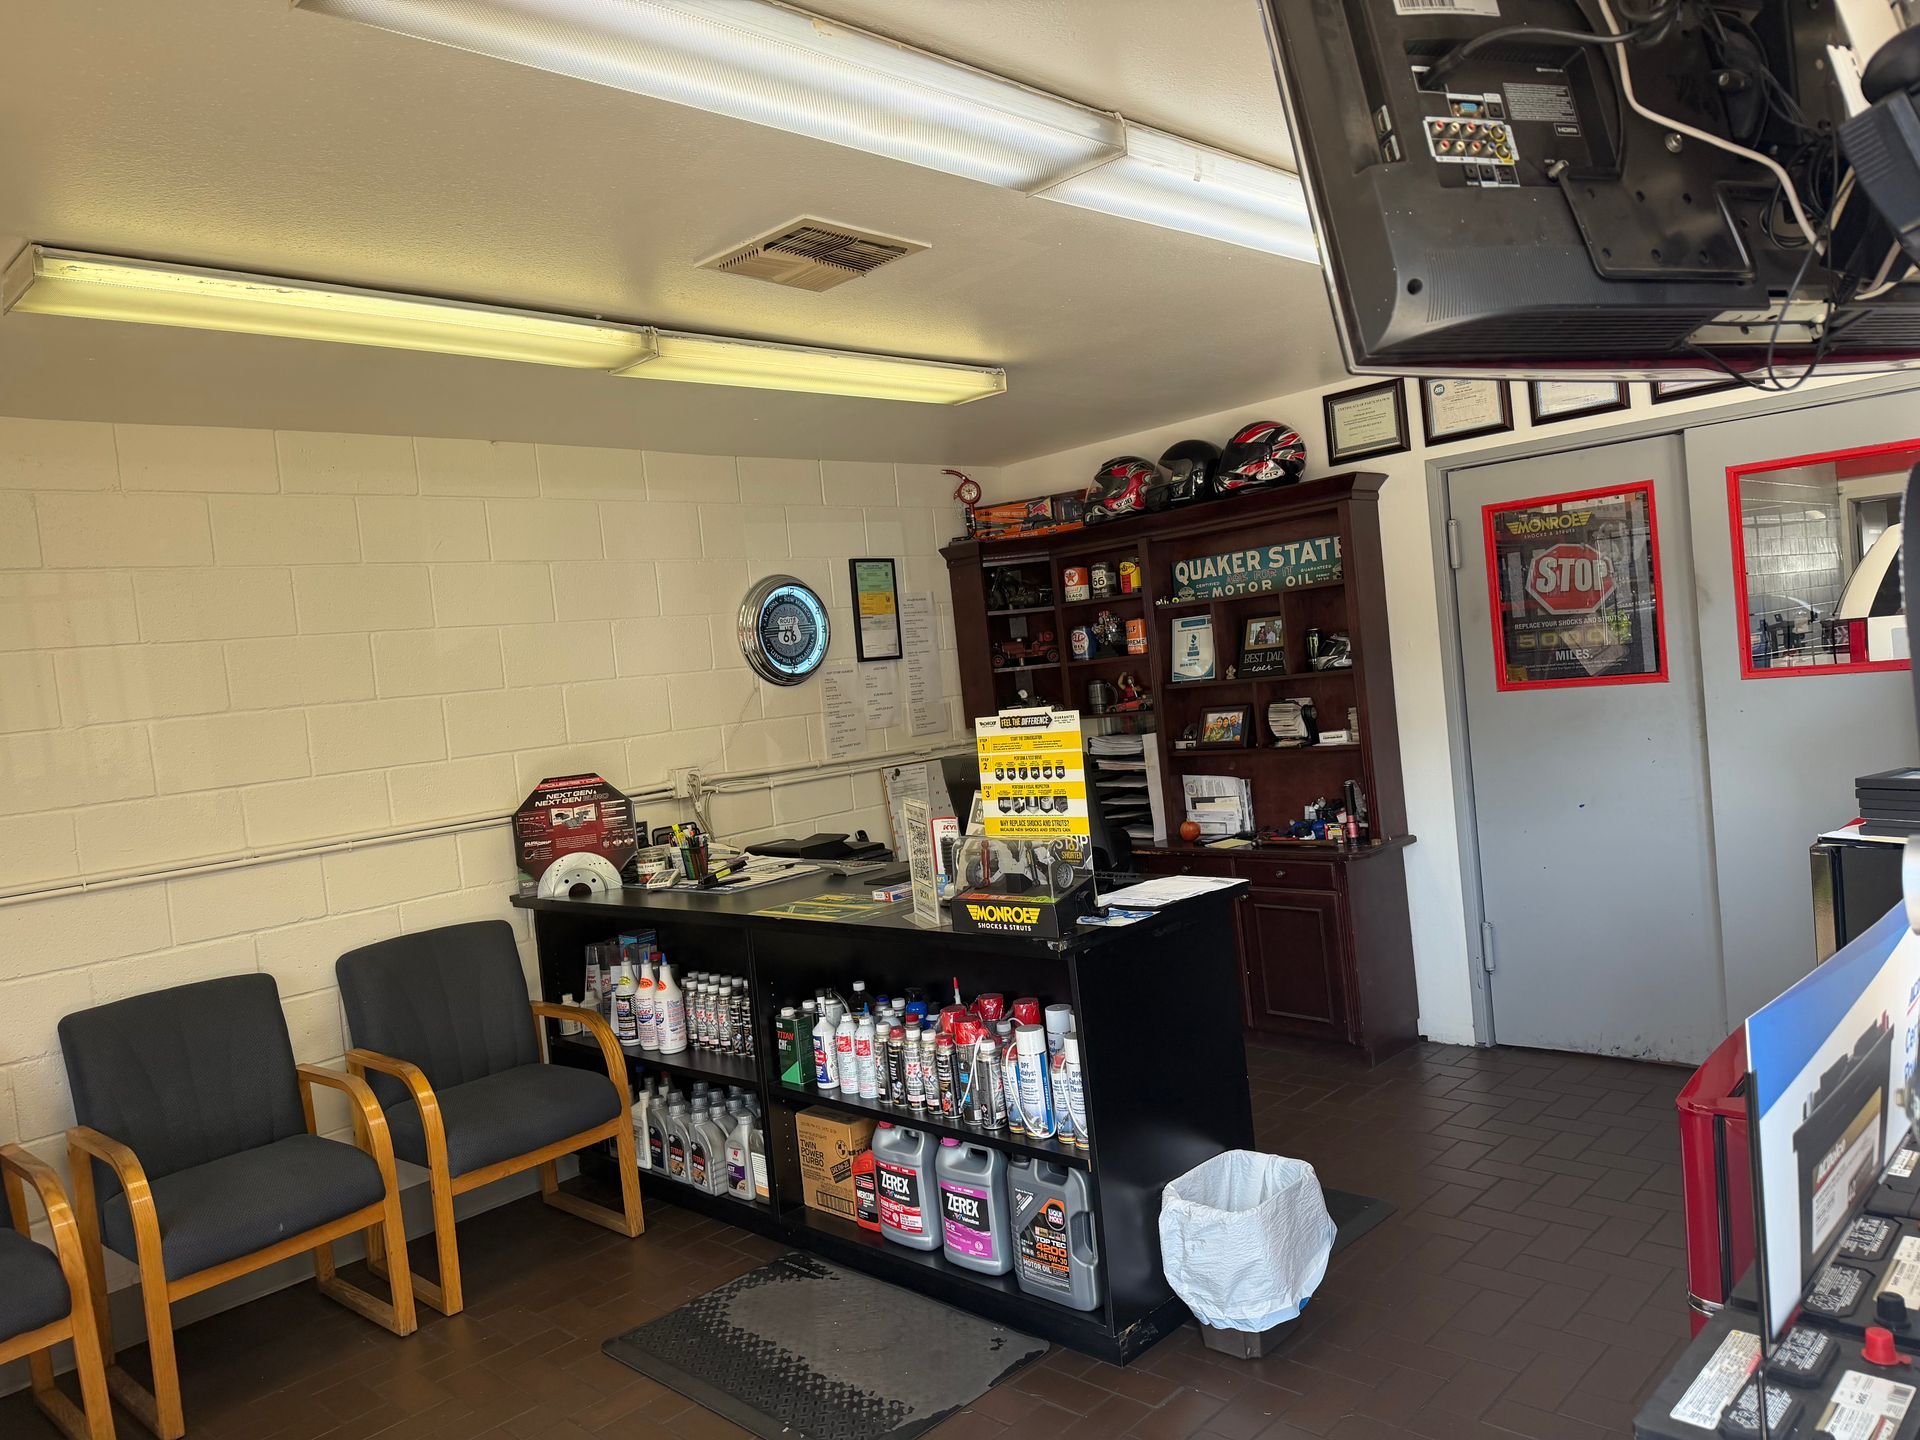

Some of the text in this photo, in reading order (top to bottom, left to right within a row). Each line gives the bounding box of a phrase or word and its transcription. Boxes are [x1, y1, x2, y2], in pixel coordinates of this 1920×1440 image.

[1518, 513, 1580, 534] MONROE
[1174, 550, 1262, 586] QUAKER
[1536, 556, 1609, 594] STOP
[1211, 573, 1314, 599] MOTOR OIL
[1514, 622, 1541, 630] REPLACE
[1558, 619, 1583, 627] SHOCKS
[1583, 616, 1597, 624] AND
[783, 630, 797, 643] 66
[1244, 650, 1285, 664] BEST DAD
[1021, 716, 1050, 727] DIFFERENCE
[546, 792, 572, 800] NEXT
[572, 789, 593, 797] GEN
[534, 799, 562, 808] NEXT
[1009, 819, 1026, 827] REPLACE
[1027, 819, 1042, 827] SHOCKS
[976, 904, 1032, 924] MONROE
[977, 922, 1002, 930] SHOCKS
[1009, 924, 1032, 932] STRUTS
[777, 1031, 794, 1041] TITAN
[800, 1139, 817, 1150] TWIN
[800, 1147, 825, 1161] POWER
[801, 1155, 825, 1168] TURBO
[880, 1170, 910, 1195] ZEREX
[856, 1189, 875, 1202] MERCON
[889, 1202, 904, 1213] VEHICLE
[946, 1192, 980, 1218] ZEREX
[1048, 1215, 1063, 1225] MOLY
[1035, 1235, 1067, 1249] TOP TEC
[1035, 1243, 1067, 1258] 4200
[1036, 1251, 1068, 1266] SAE 5W-30
[1023, 1259, 1052, 1274] MOTOR OIL
